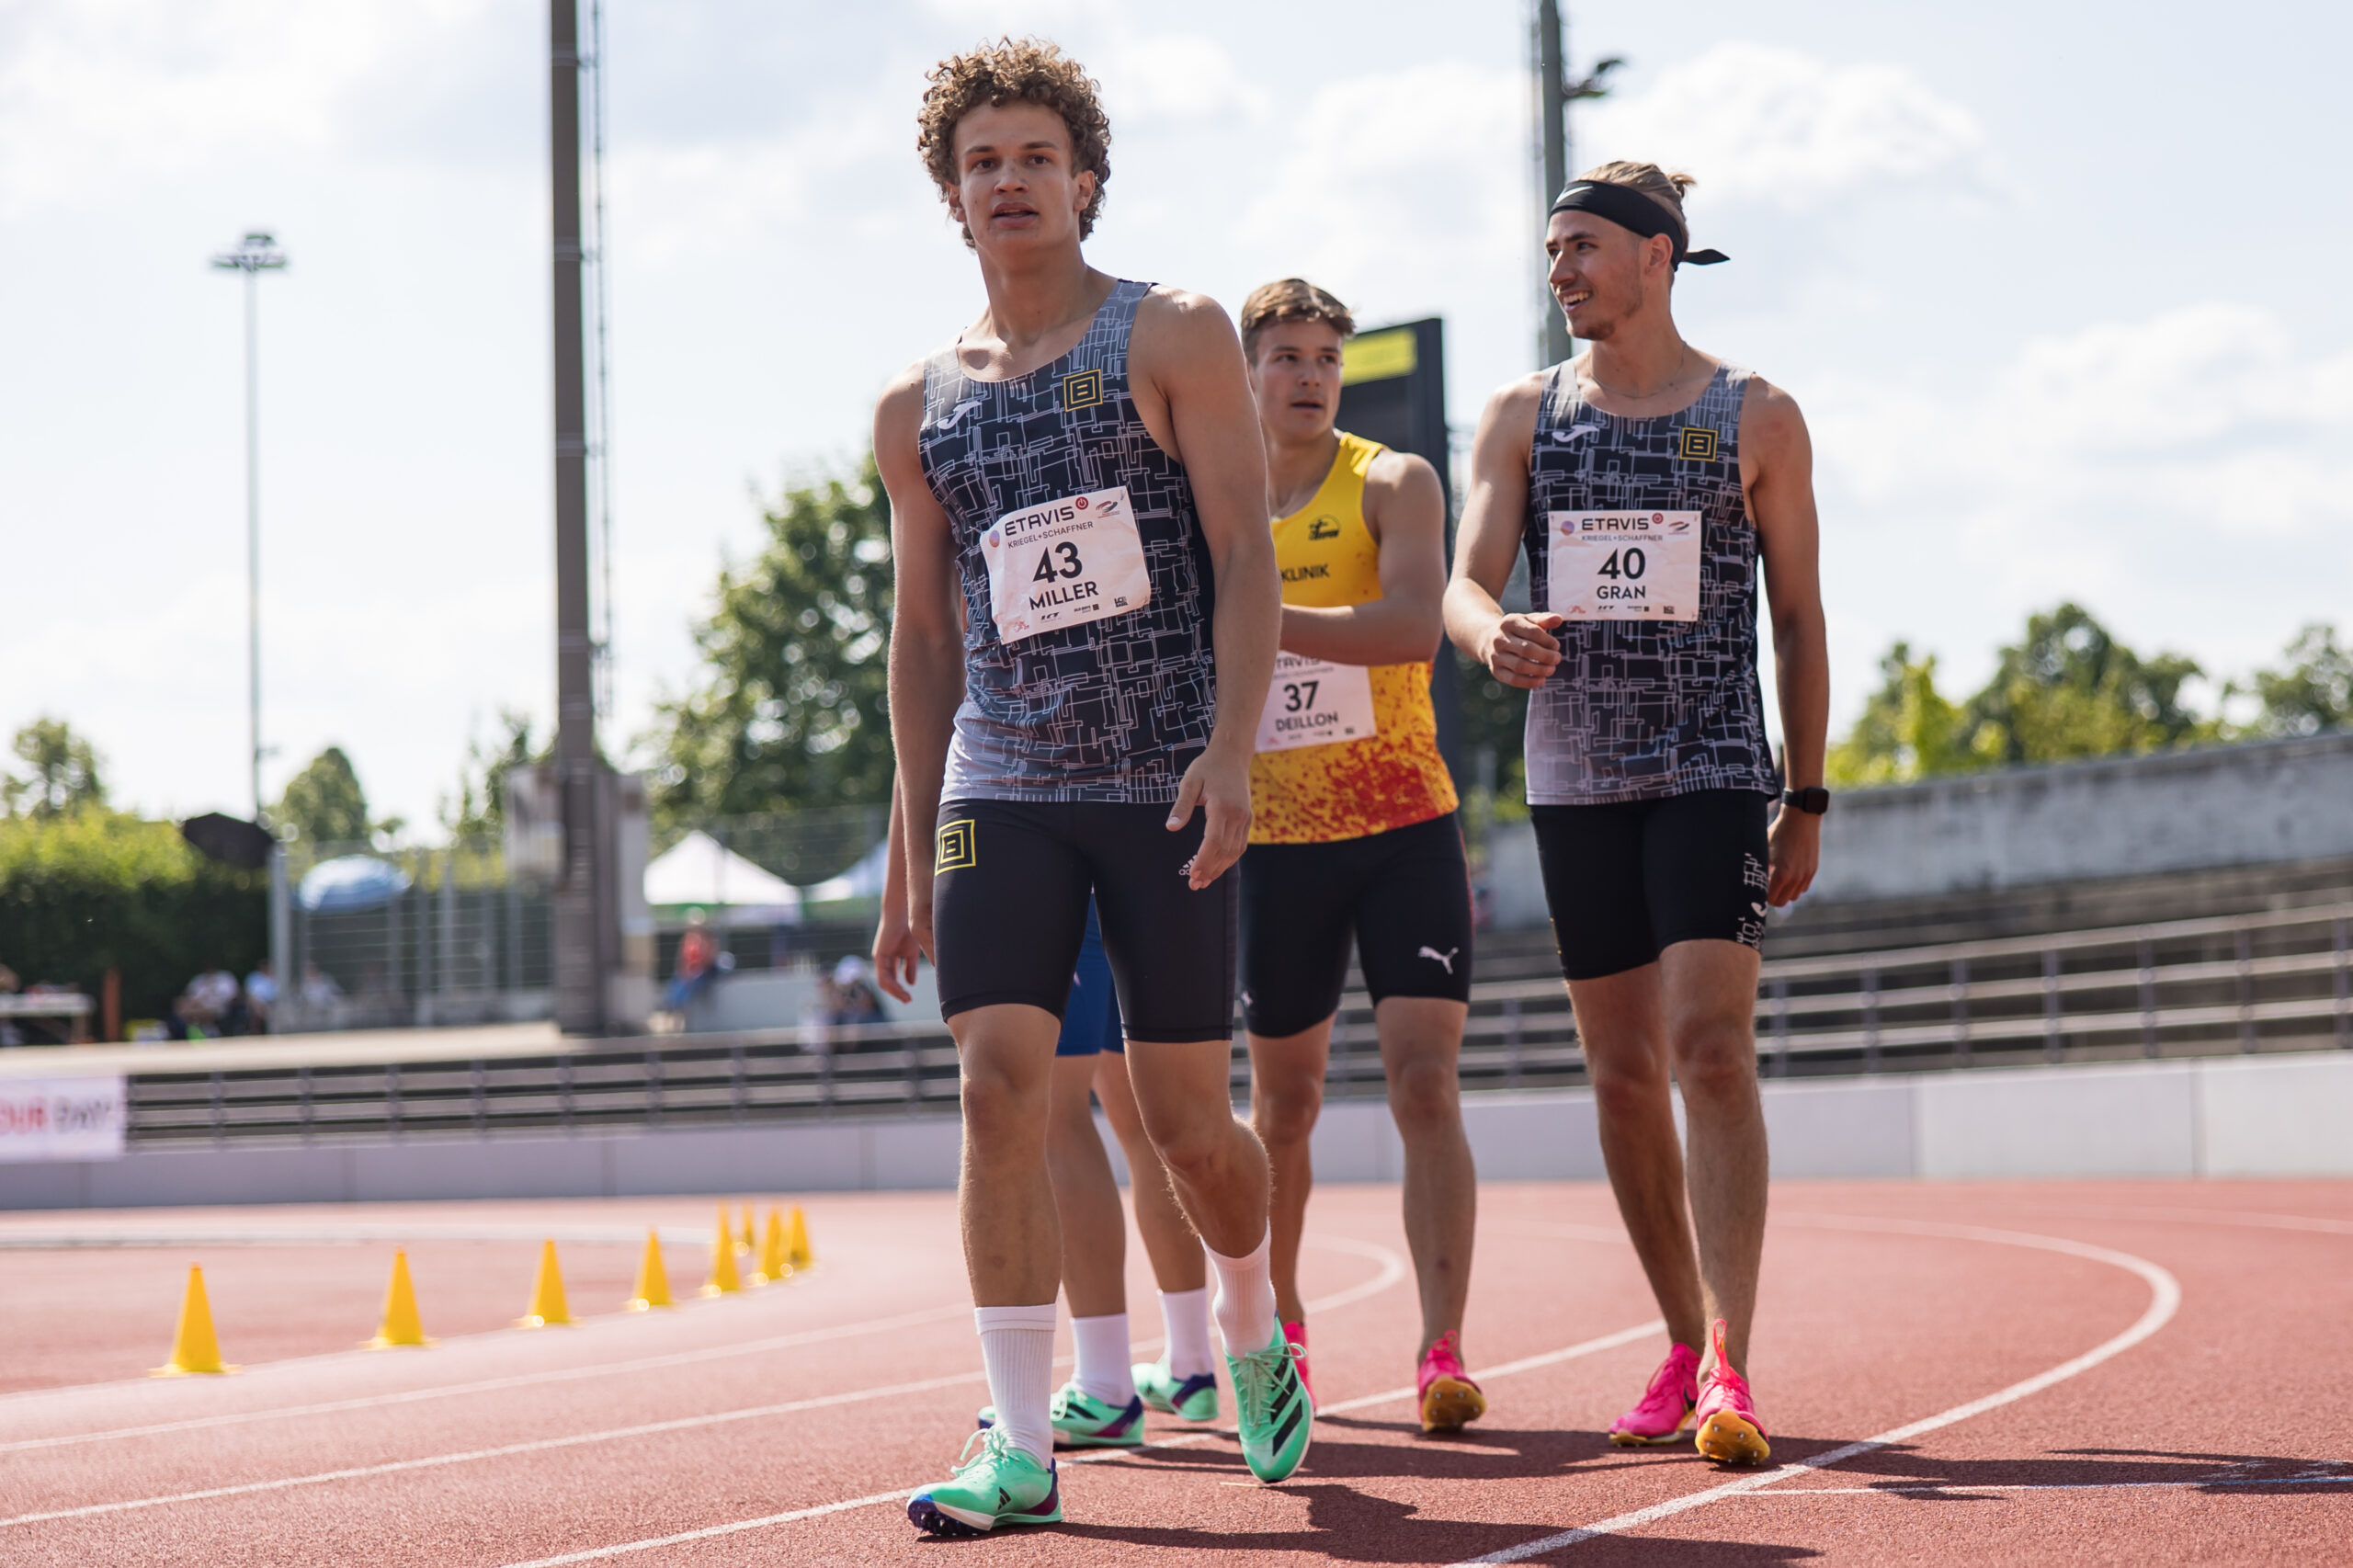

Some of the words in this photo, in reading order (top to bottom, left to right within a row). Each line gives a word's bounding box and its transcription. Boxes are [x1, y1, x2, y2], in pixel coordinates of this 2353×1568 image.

[1005, 506, 1074, 536] ETAVIS
[1582, 517, 1649, 530] ETAVIS
[1032, 541, 1083, 584] 43
[1597, 548, 1645, 580] 40
[1029, 581, 1099, 610] MILLER
[1597, 585, 1646, 599] GRAN
[1277, 655, 1320, 669] TAVIS
[1284, 680, 1319, 712] 37
[1275, 711, 1338, 733] DEILLON
